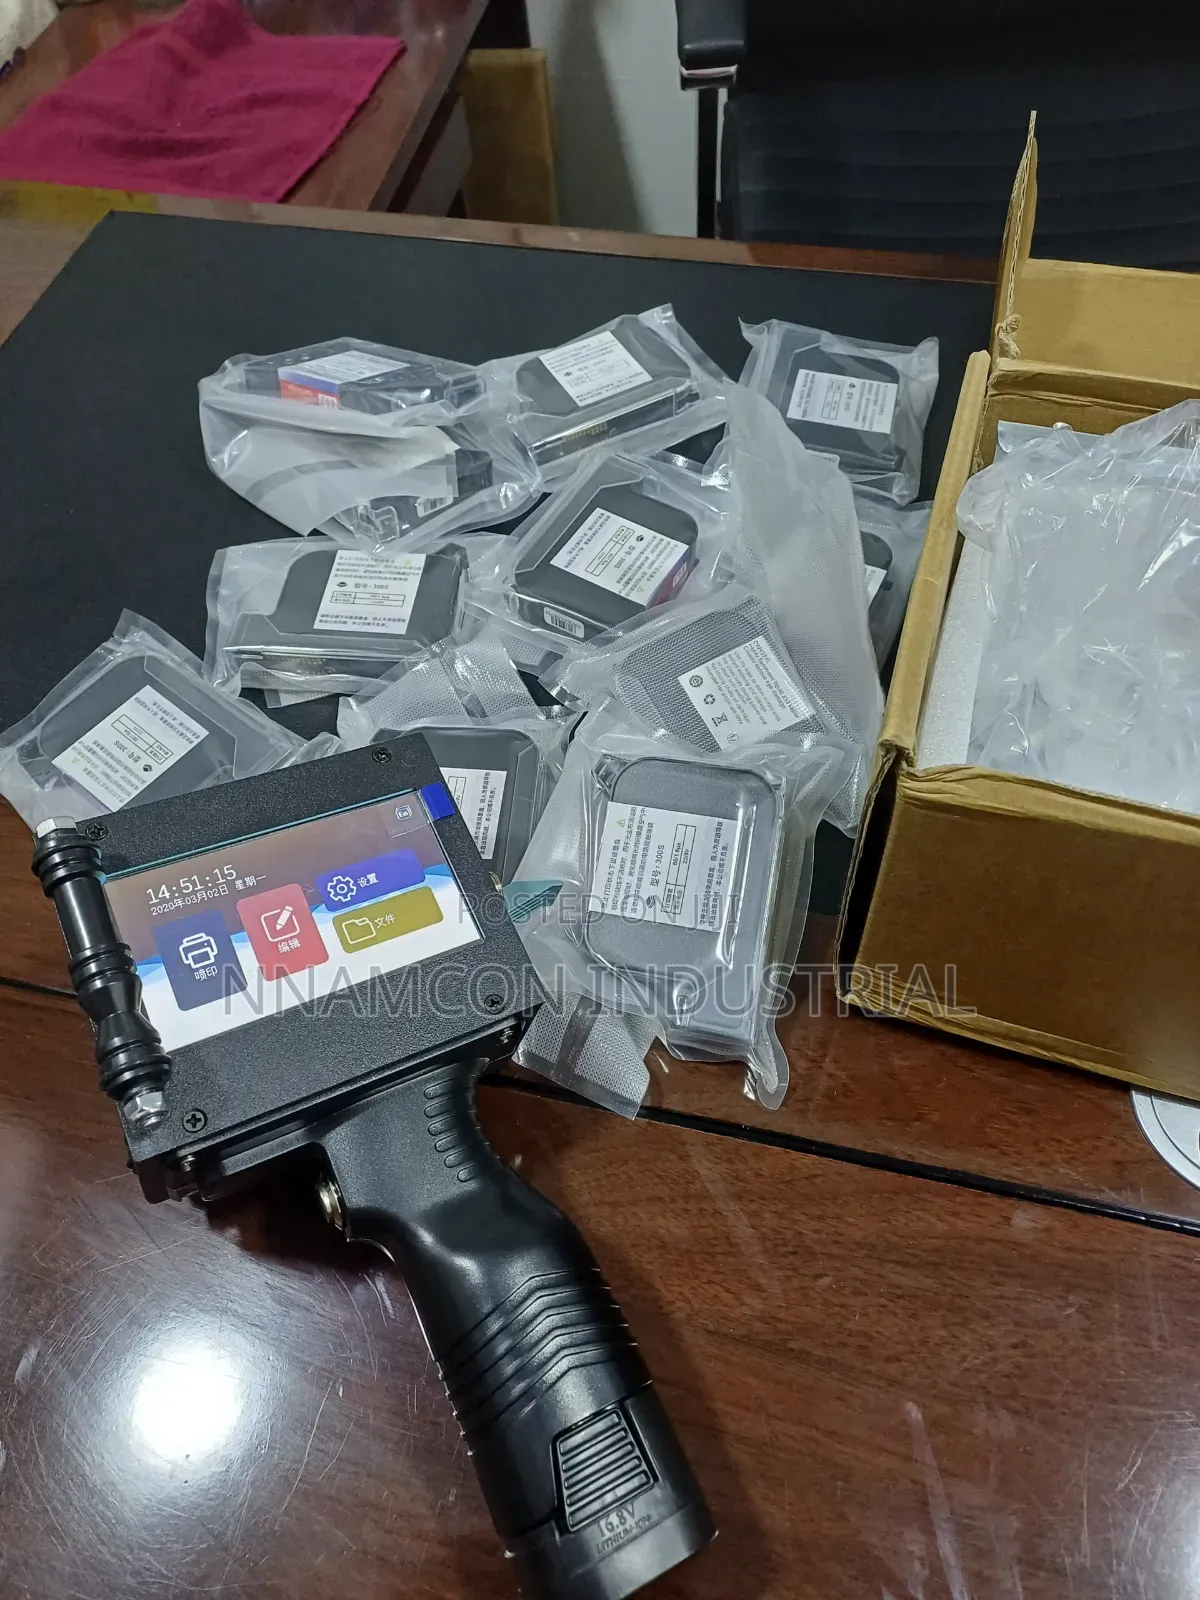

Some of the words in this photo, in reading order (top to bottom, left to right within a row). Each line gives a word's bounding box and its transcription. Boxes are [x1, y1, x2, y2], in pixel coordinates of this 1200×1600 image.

[147, 865, 236, 904] 14:51:15
[358, 872, 378, 887] 设置
[150, 884, 228, 916] 2020年03月02日
[235, 876, 266, 890] 星期一
[374, 914, 396, 928] 文件
[278, 938, 300, 953] 编辑
[194, 966, 218, 980] 喷印
[598, 1502, 636, 1538] 16.8V
